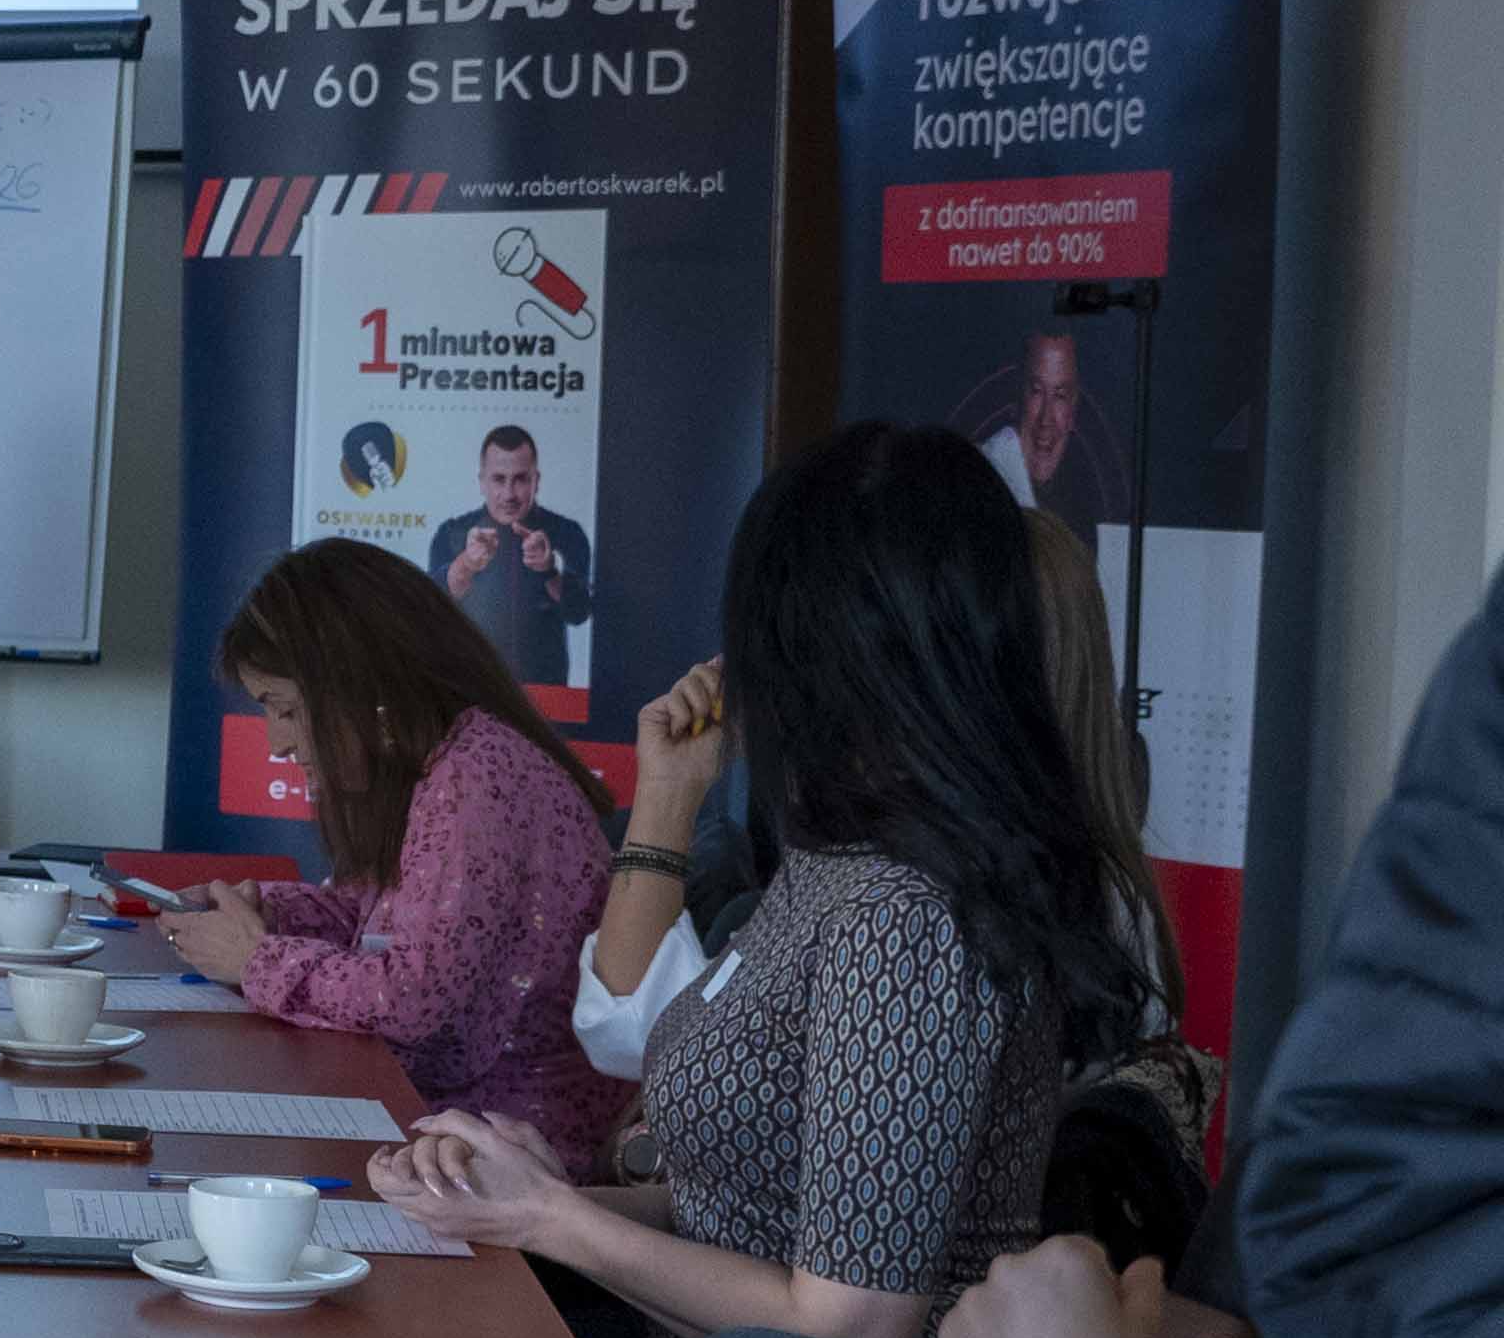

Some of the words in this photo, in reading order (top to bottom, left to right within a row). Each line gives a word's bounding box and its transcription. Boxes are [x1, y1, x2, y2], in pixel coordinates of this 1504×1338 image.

[238, 67, 288, 112] W
[313, 63, 380, 109] 60
[406, 49, 690, 105] SEKUND
[913, 24, 1151, 100] zwiększające
[912, 82, 1146, 159] kompetencje
[459, 170, 726, 201] www.robertoskwarek.pl
[918, 207, 932, 231] z
[937, 191, 1138, 231] dofinansowaniem
[949, 236, 1022, 267] nawet
[1026, 233, 1051, 265] do
[1057, 231, 1105, 264] 90%
[359, 308, 399, 374] 1
[400, 327, 555, 356] minutowa
[399, 363, 584, 398] Prezentacja
